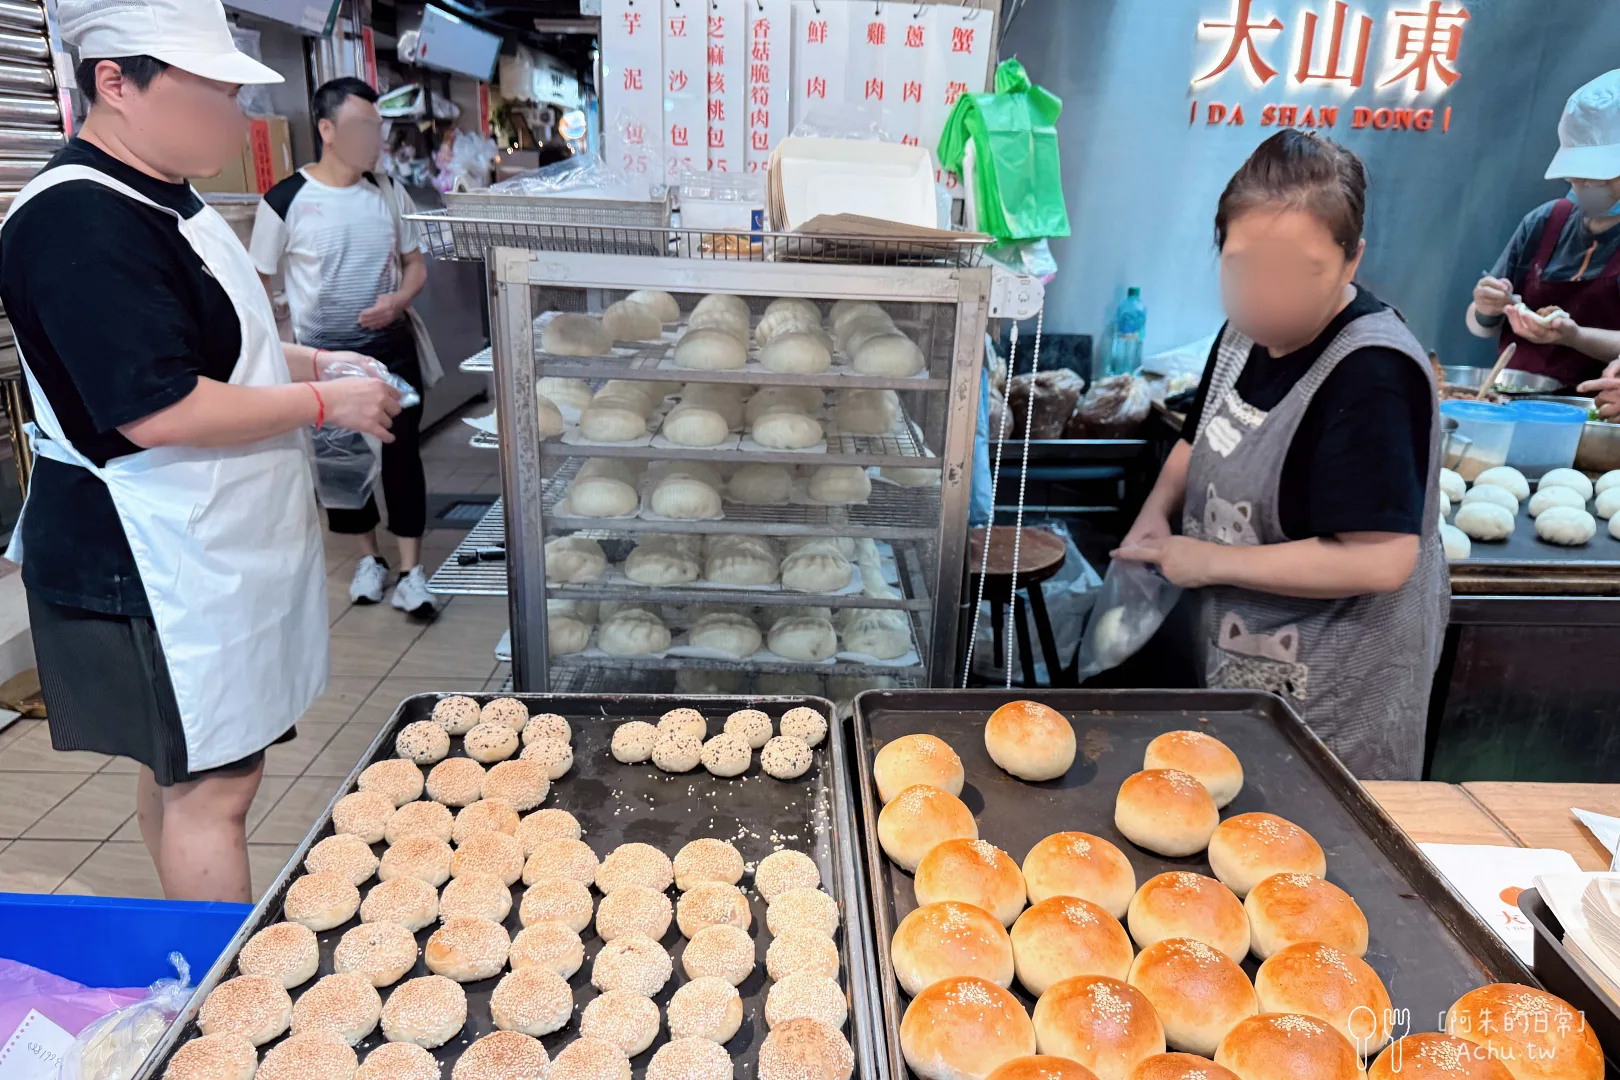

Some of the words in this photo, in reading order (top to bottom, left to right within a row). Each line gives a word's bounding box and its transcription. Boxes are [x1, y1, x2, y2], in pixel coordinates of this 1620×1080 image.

[622, 11, 643, 145] 芋泥包
[668, 15, 689, 147] 豆沙包
[750, 17, 771, 151] 香菇脆筍肉包
[1192, 0, 1472, 92] 大山東
[623, 154, 648, 175] 25
[1207, 103, 1245, 125] DA
[1260, 104, 1339, 127] SHAN
[1351, 106, 1434, 130] DONG
